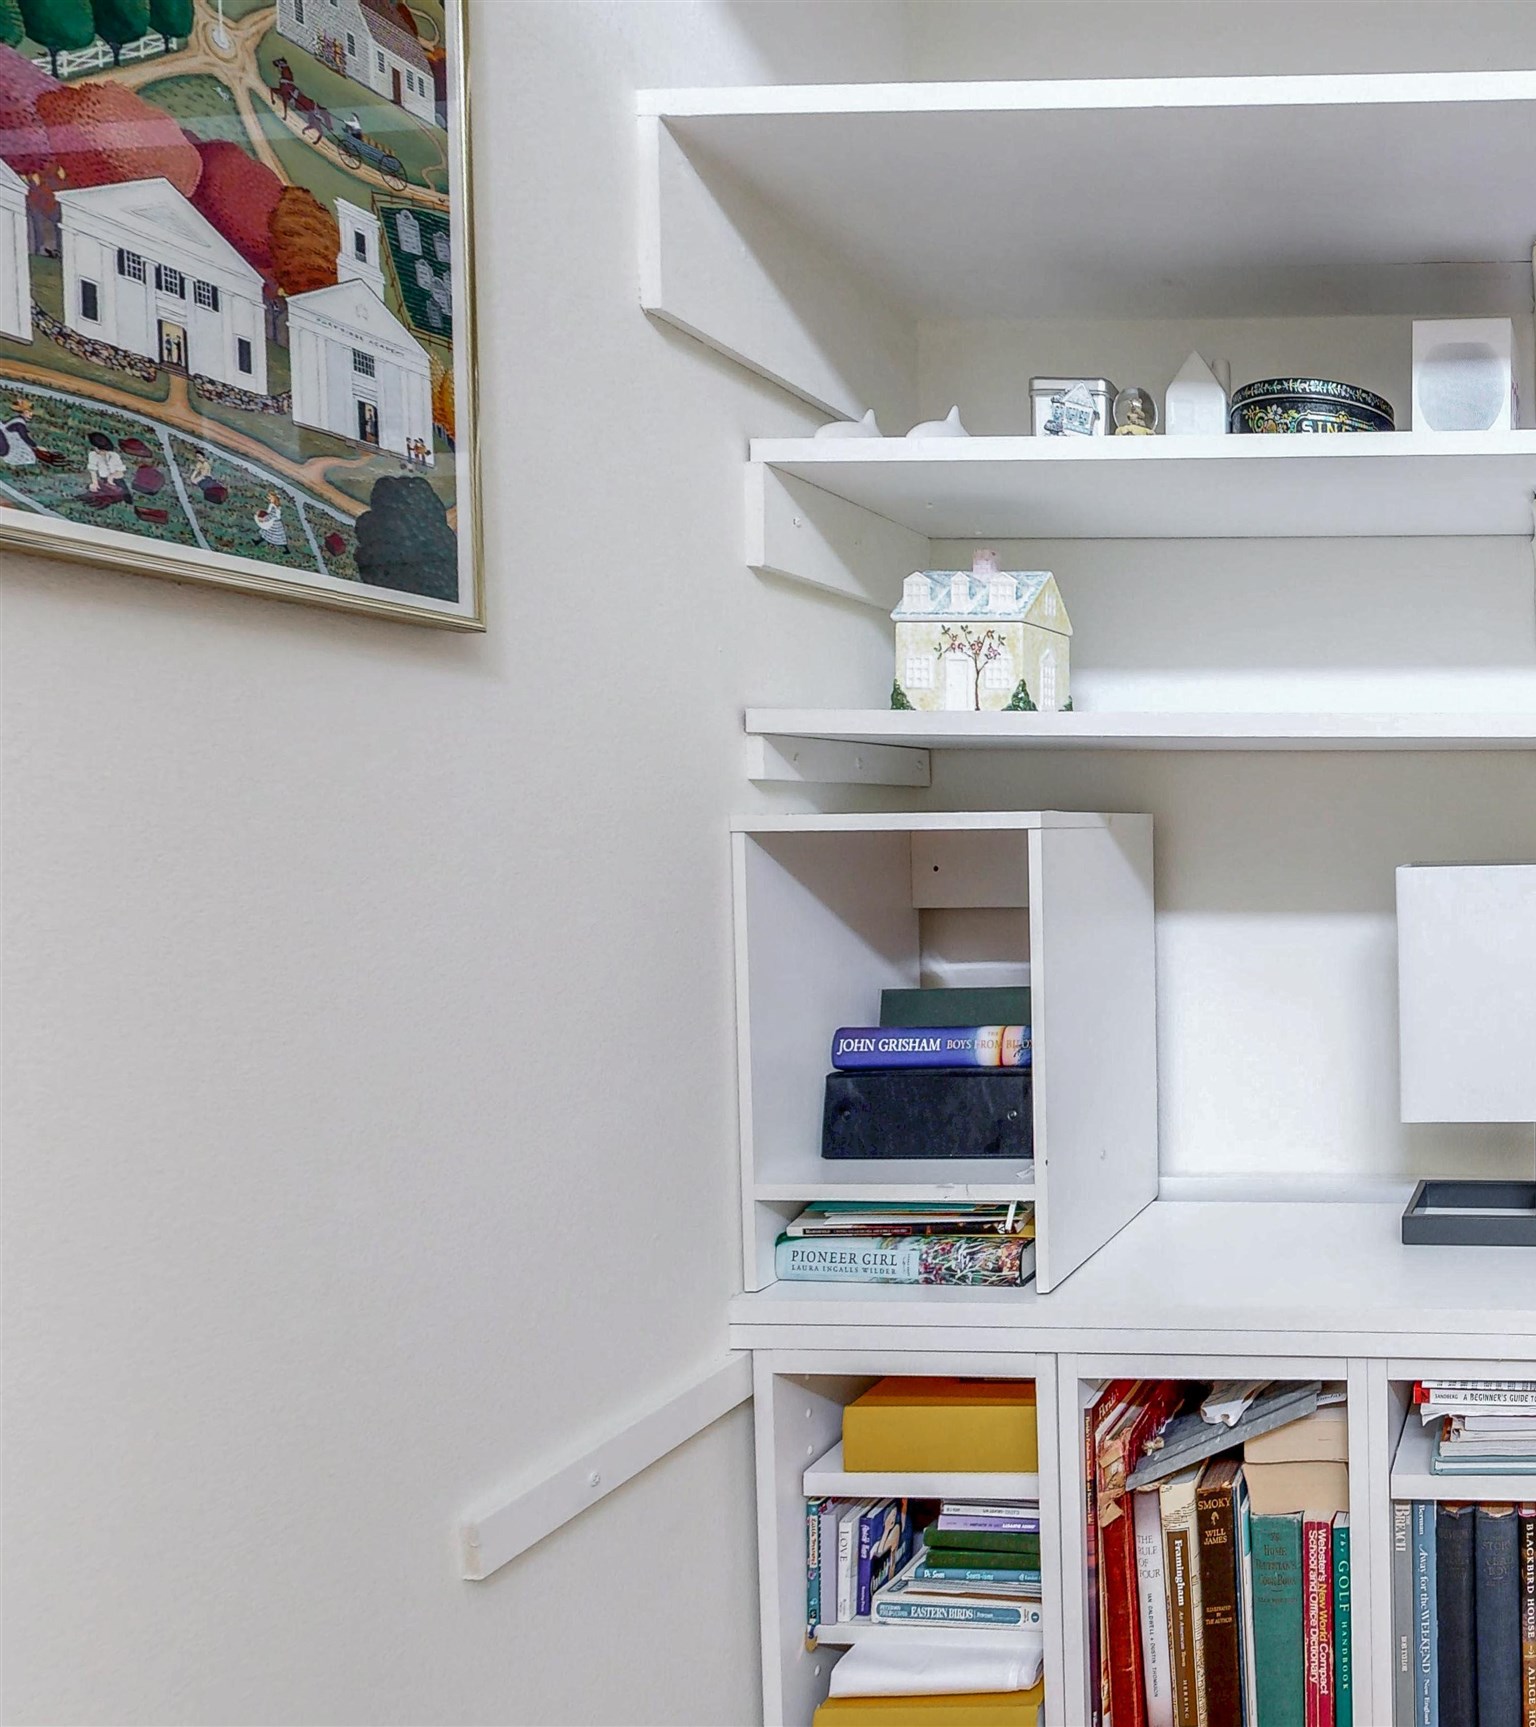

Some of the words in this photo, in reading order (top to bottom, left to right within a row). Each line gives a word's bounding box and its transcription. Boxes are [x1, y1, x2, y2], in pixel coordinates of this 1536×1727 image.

[837, 1039, 875, 1055] JOHN
[878, 1038, 941, 1052] GRISHAM
[946, 1039, 971, 1049] BOYS
[974, 1039, 1001, 1050] FROM
[791, 1250, 857, 1265] PIONEER
[862, 1253, 897, 1266] GIRL
[862, 1267, 896, 1275] WILDER
[1463, 1393, 1468, 1401] A
[1470, 1393, 1507, 1402] BEGINNER'S
[1198, 1498, 1231, 1510] SMOKY
[1205, 1528, 1226, 1537] WILL
[1394, 1504, 1410, 1551] BREACH
[1418, 1505, 1426, 1535] Berman
[840, 1531, 849, 1562] LOVE
[1137, 1535, 1153, 1544] THE
[1138, 1546, 1157, 1555] RULE
[1204, 1535, 1228, 1545] JAMES
[1309, 1530, 1318, 1567] School
[1138, 1558, 1148, 1567] OF
[1318, 1529, 1329, 1582] Webster's
[1418, 1544, 1429, 1573] Away
[1526, 1524, 1535, 1593] BLACKBIRD
[1139, 1569, 1161, 1578] FOUR
[1309, 1570, 1319, 1592] and
[1339, 1560, 1349, 1612] GOLF
[1420, 1576, 1429, 1591] for
[1310, 1593, 1320, 1626] Office
[1319, 1583, 1329, 1610] New
[1420, 1593, 1430, 1609] the
[910, 1606, 948, 1618] EASTERN
[949, 1607, 973, 1619] BIRDS
[1319, 1610, 1329, 1642] World
[1527, 1598, 1535, 1639] HOUSE
[1174, 1540, 1187, 1606] Framingham
[1182, 1680, 1190, 1719] HERRING
[1419, 1609, 1431, 1674] WEEKEND
[1147, 1605, 1155, 1635] CALDWELL
[1151, 1667, 1159, 1697] THOMASON
[1309, 1628, 1320, 1684] Dictionary
[1341, 1621, 1349, 1691] HANDBOOK
[1318, 1643, 1329, 1695] Compact
[1528, 1667, 1536, 1705] ALICE
[1423, 1697, 1431, 1725] England
